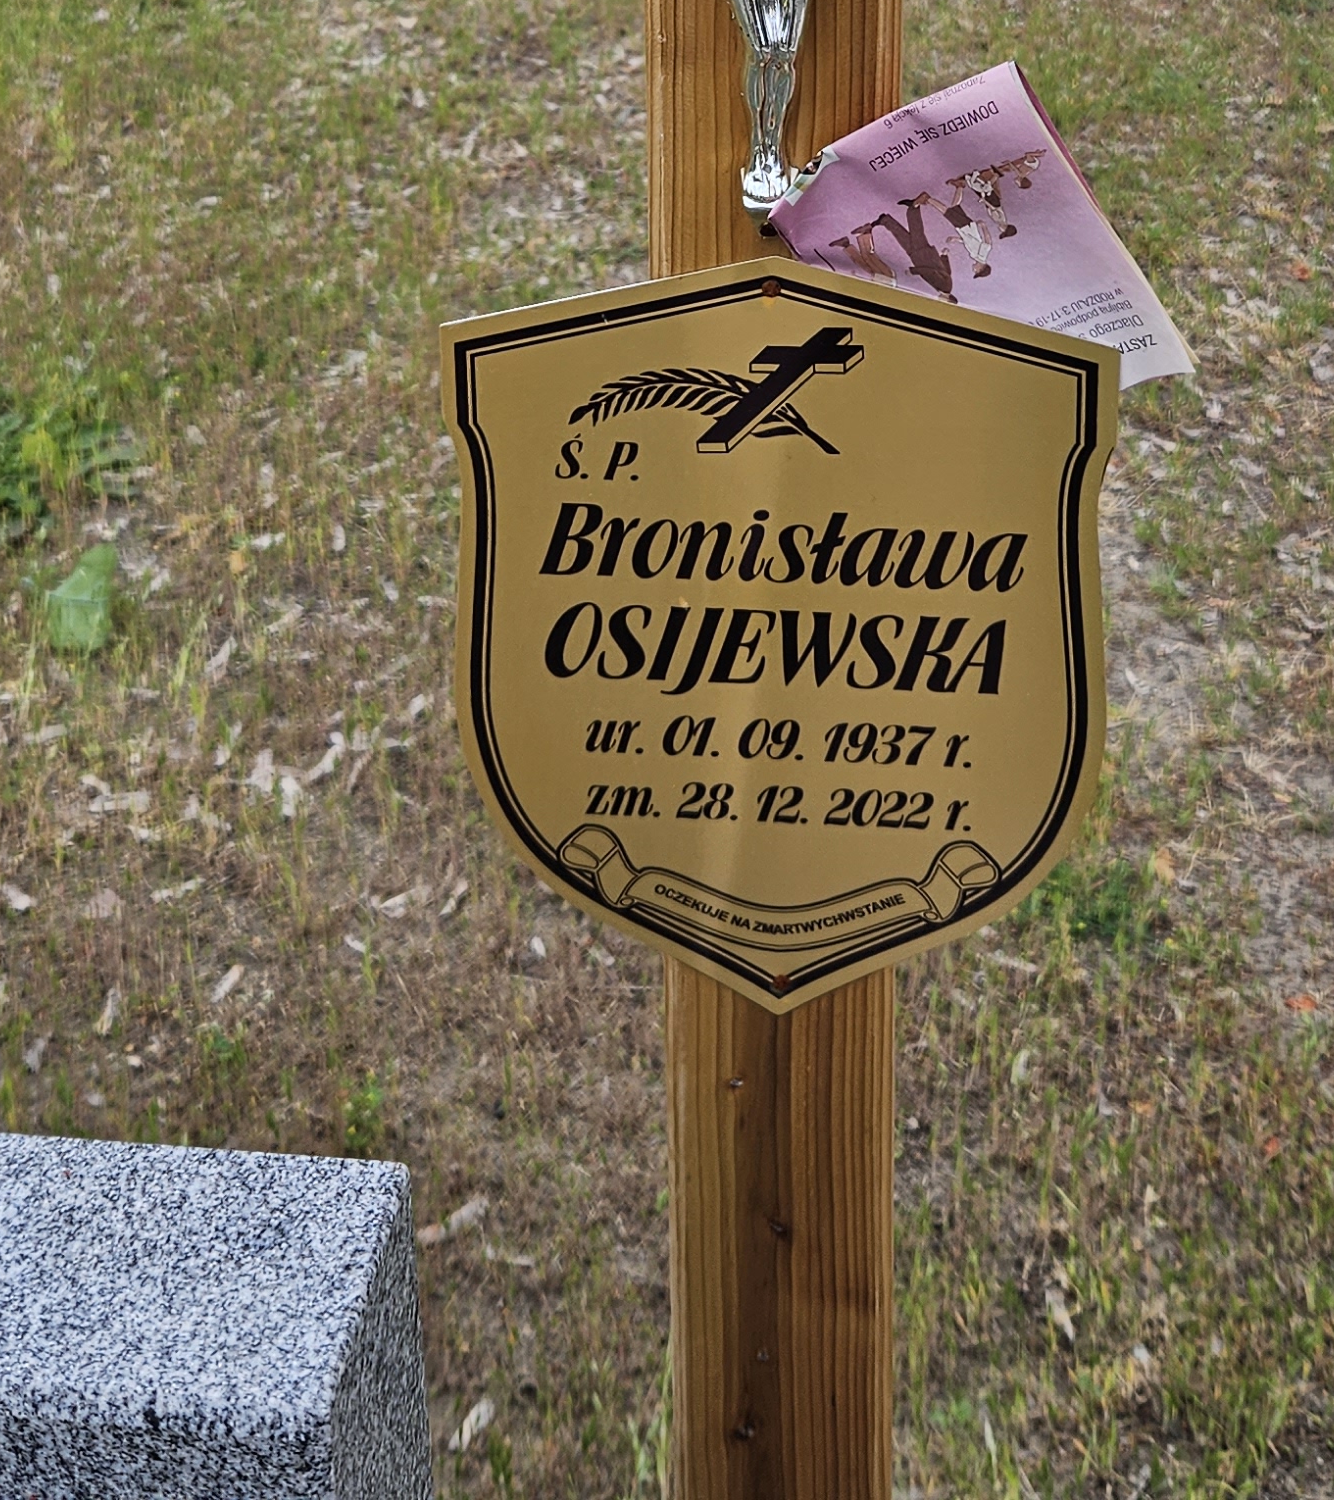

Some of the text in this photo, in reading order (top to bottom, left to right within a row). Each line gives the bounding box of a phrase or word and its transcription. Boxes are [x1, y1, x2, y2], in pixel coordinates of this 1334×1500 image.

[868, 100, 1000, 172] DOWIEDZ SIĘ WIĘCEJ
[883, 119, 894, 130] 6
[1070, 290, 1116, 314] RODZAJU
[1088, 313, 1145, 339] Dlaczego
[1099, 299, 1134, 315] Biblijną
[1113, 333, 1158, 355] ZASTA
[554, 433, 640, 481] Ś. P.
[538, 501, 1029, 594] Bronisława
[543, 601, 1008, 696] OSIJEWSKA
[584, 714, 972, 769] ur. 01. 09. 1937 r.
[584, 781, 972, 833] zm. 28. 12. 2022 r.
[654, 883, 907, 935] OCZEKUJE NA ZMARTWYCHWSTANIE
